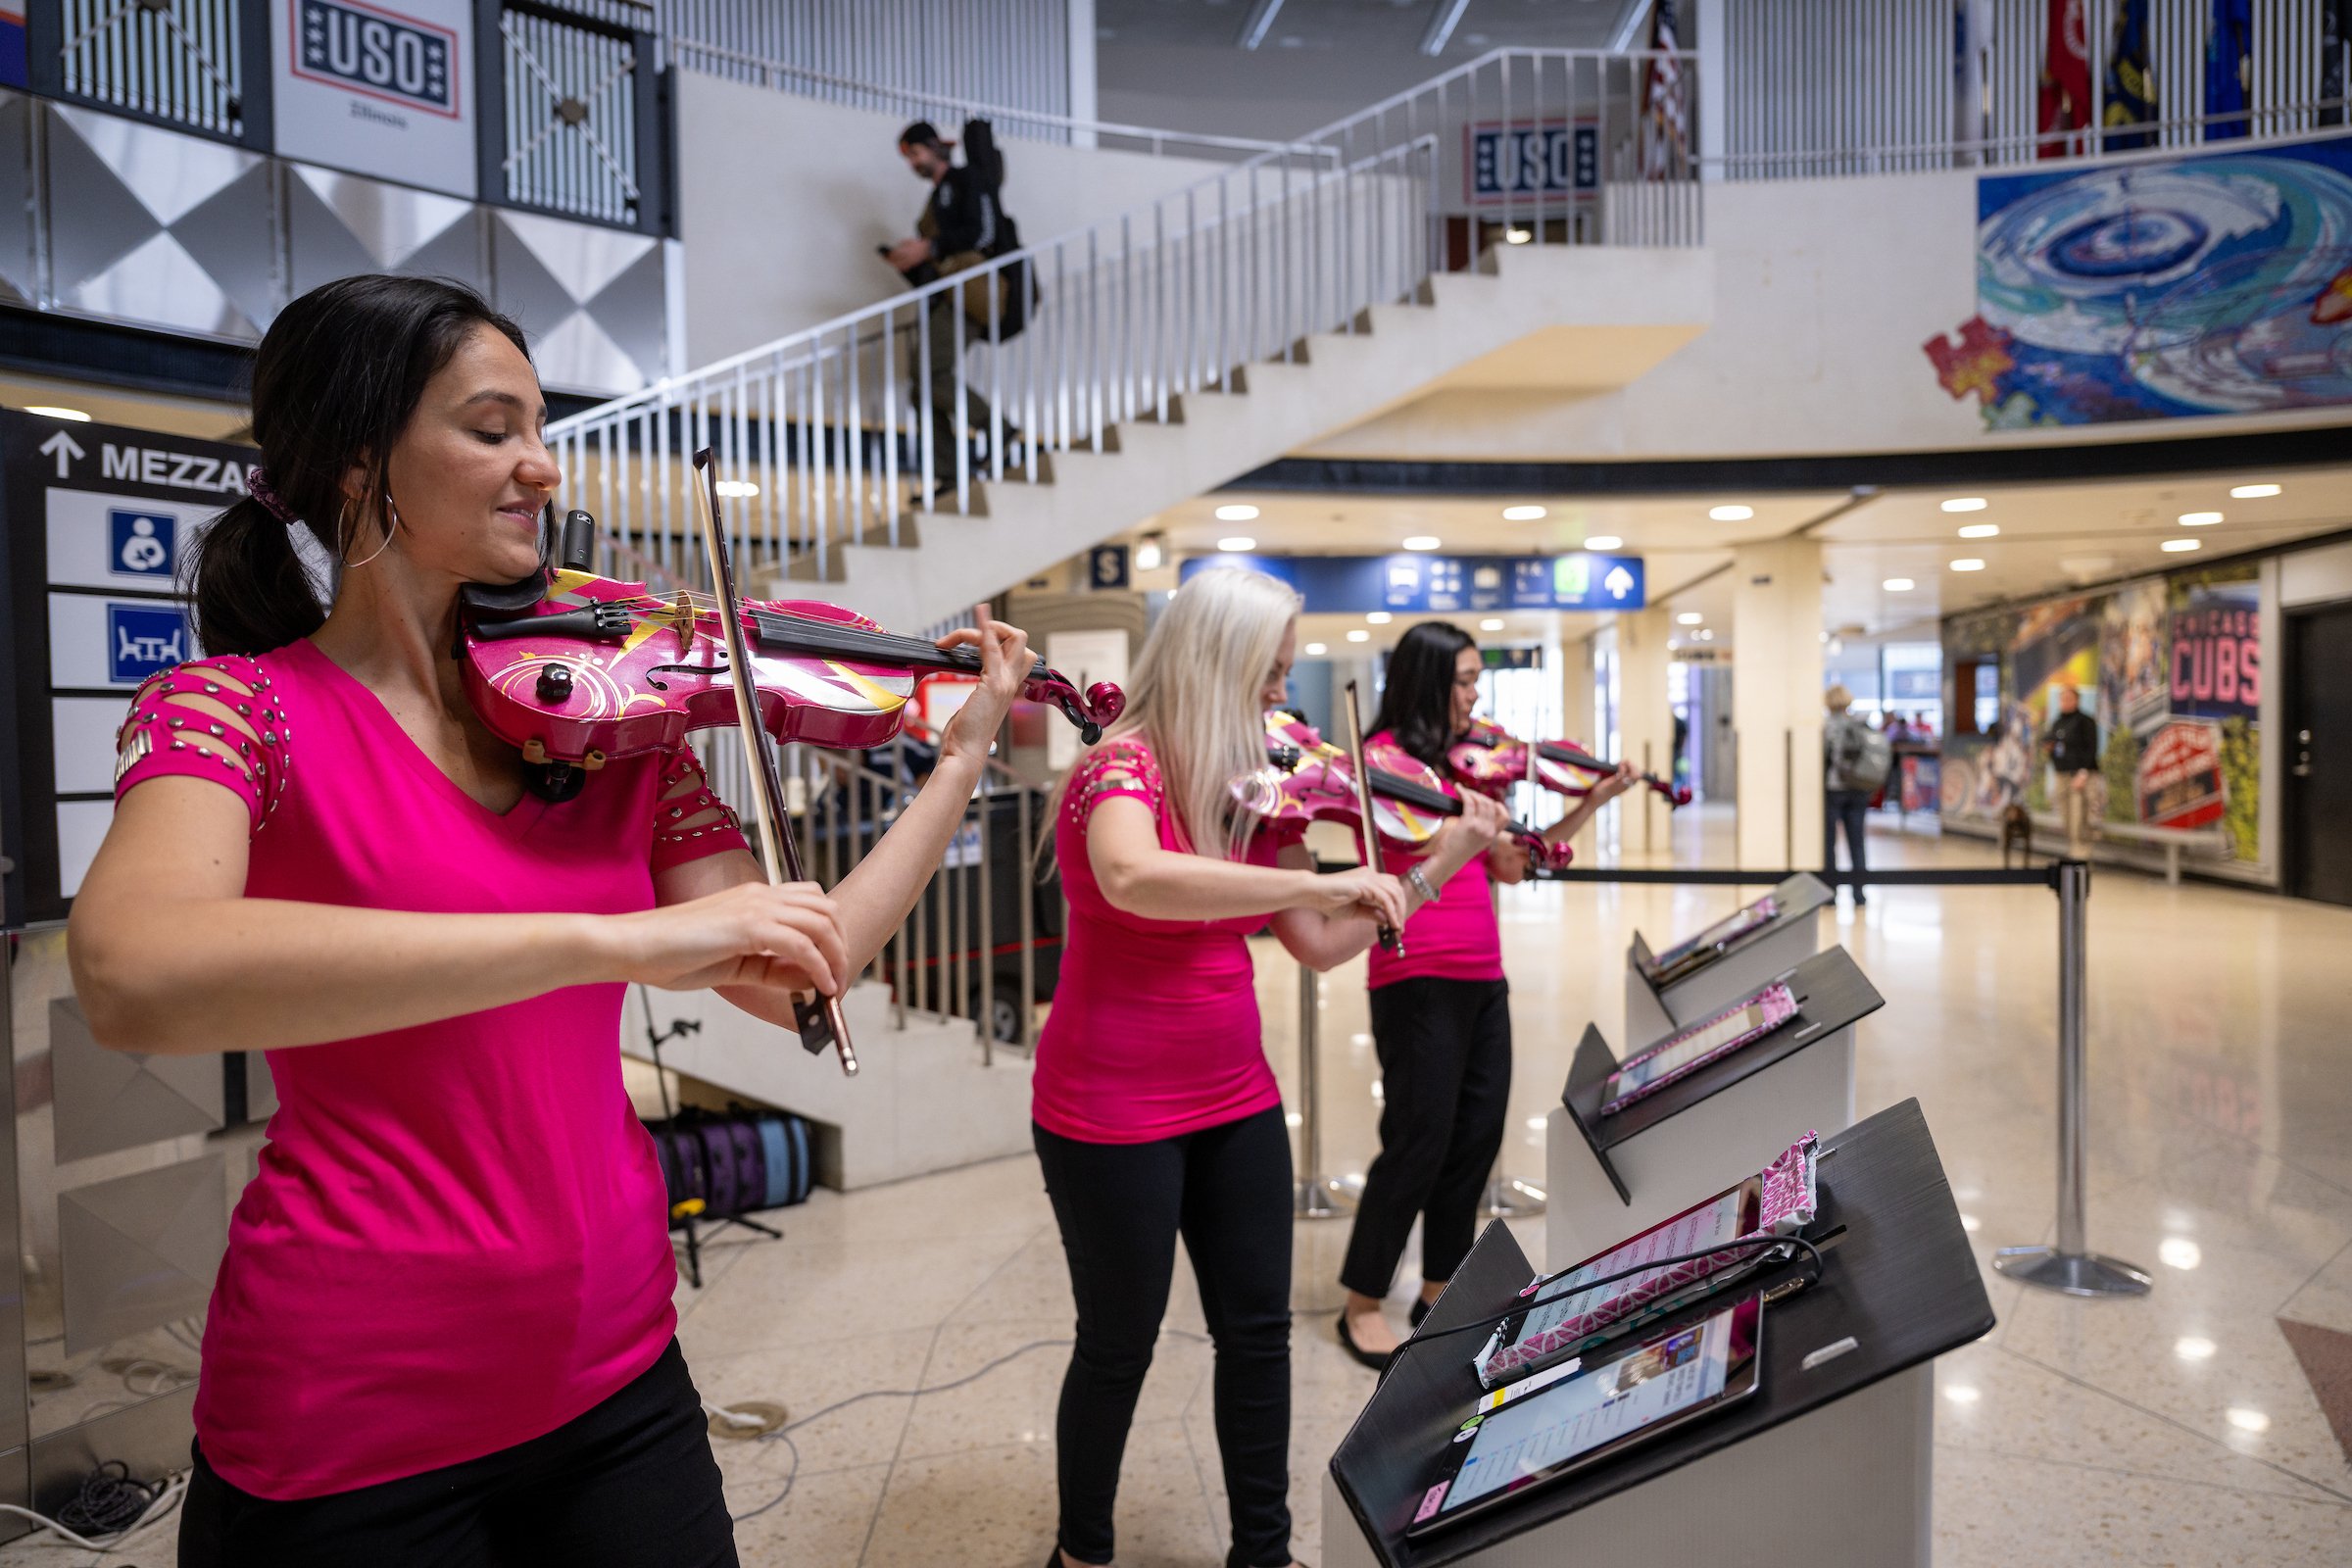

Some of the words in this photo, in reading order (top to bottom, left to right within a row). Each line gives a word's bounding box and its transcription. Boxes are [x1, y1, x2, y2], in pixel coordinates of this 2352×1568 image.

[327, 9, 424, 94] USO
[1495, 133, 1573, 189] USO
[2172, 637, 2260, 706] CUBS
